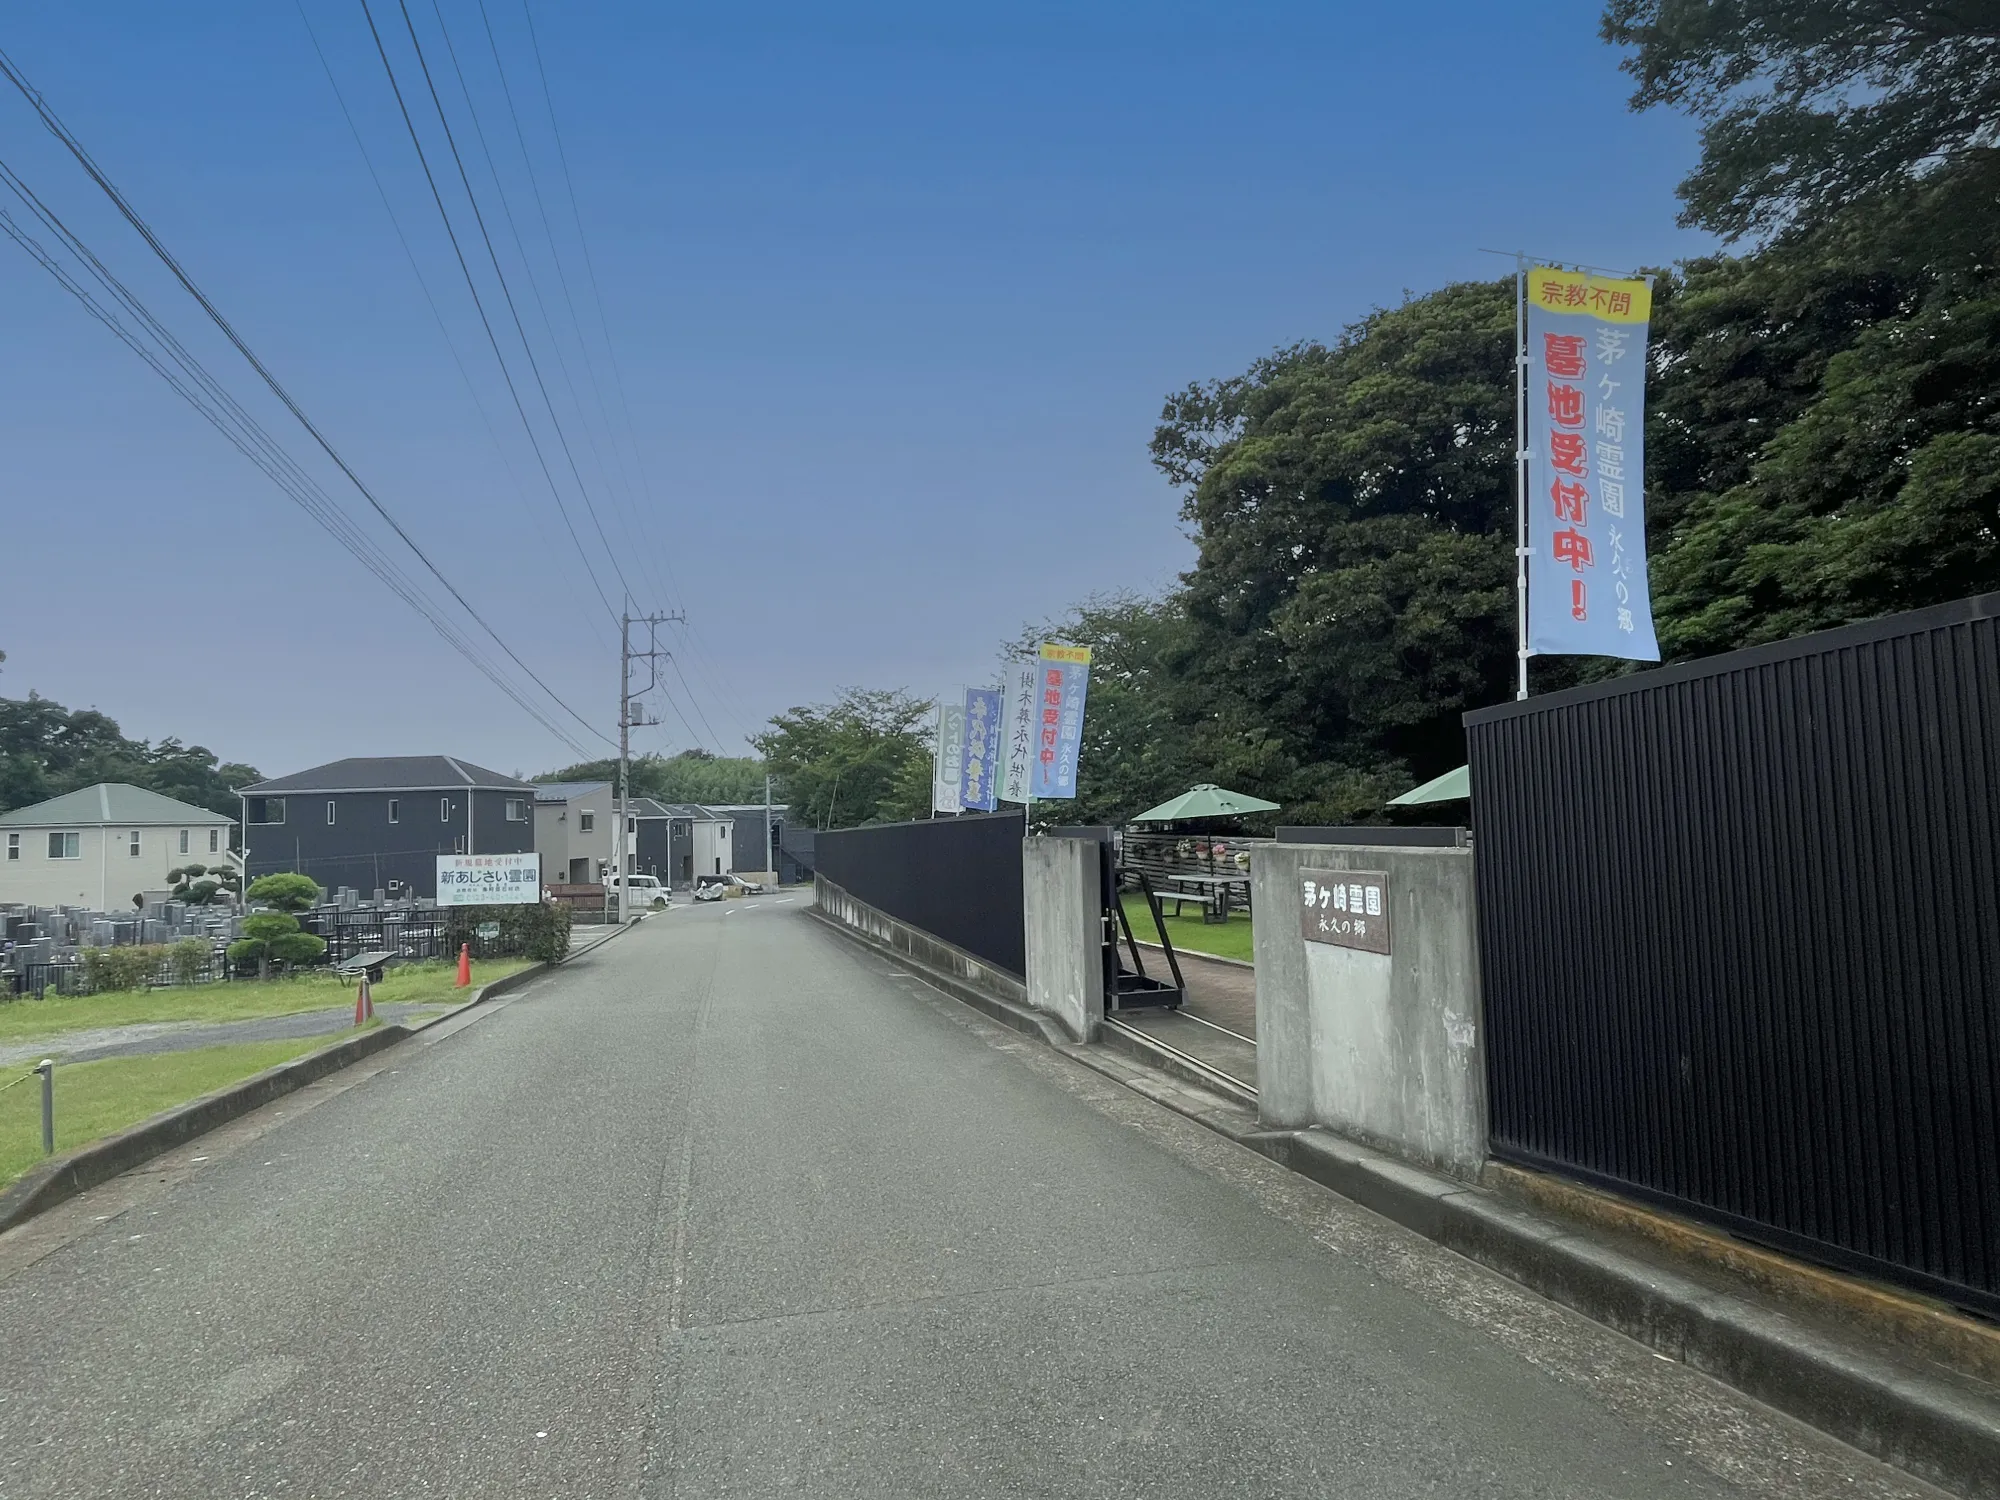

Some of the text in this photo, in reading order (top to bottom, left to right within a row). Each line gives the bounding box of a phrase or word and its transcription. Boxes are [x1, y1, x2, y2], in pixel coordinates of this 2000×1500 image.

[1541, 281, 1632, 316] 宗教不問
[1046, 649, 1085, 661] 宗教不問
[441, 869, 537, 884] 新あじさい霊園
